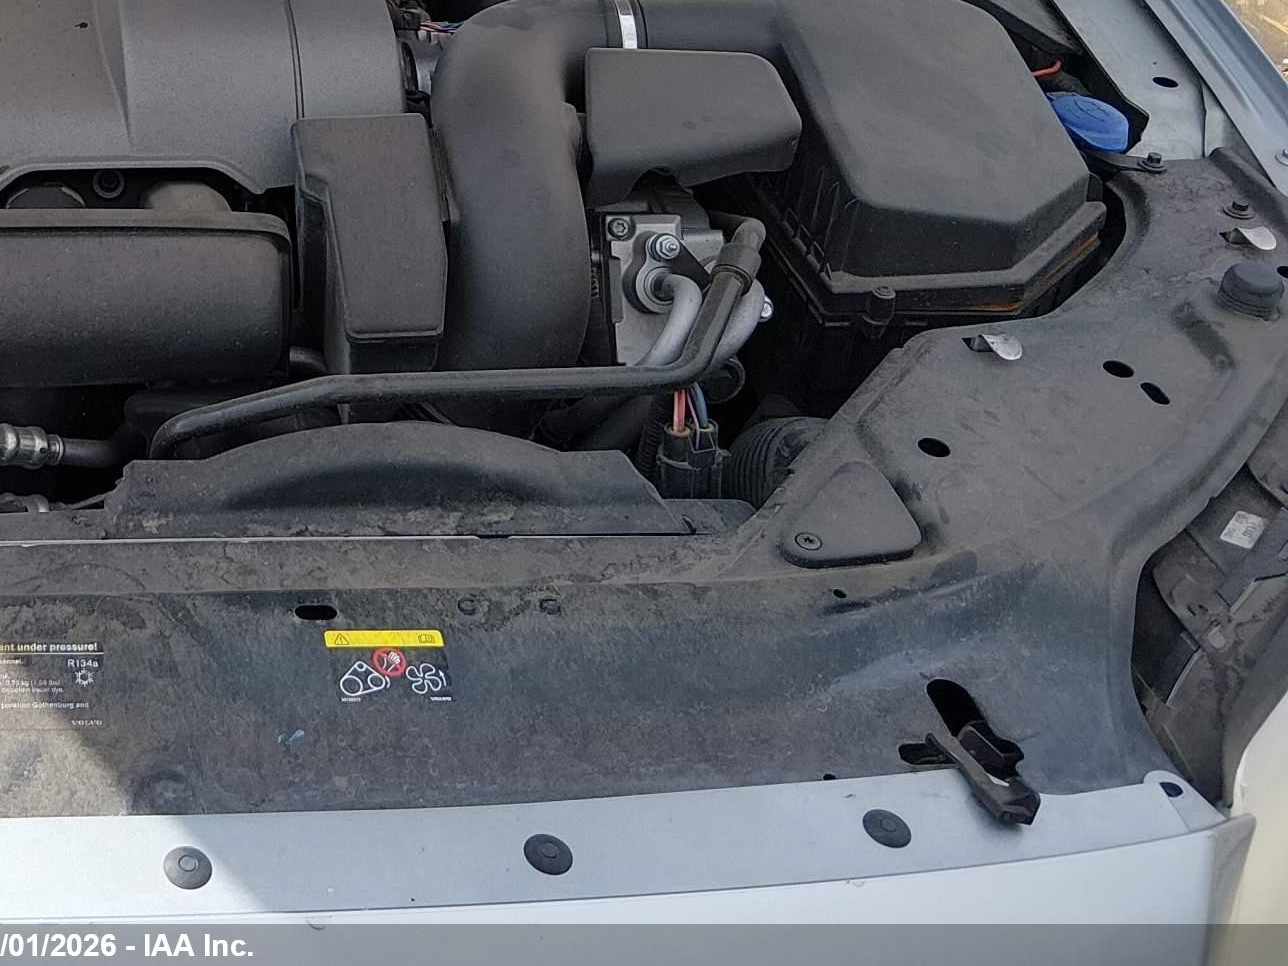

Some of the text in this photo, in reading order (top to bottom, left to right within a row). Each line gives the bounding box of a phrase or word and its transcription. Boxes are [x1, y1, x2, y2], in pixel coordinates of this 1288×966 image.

[17, 642, 47, 651] under
[50, 642, 98, 653] pressure!
[67, 658, 99, 668] R134a
[32, 701, 74, 710] Gothenburg
[75, 701, 89, 709] and
